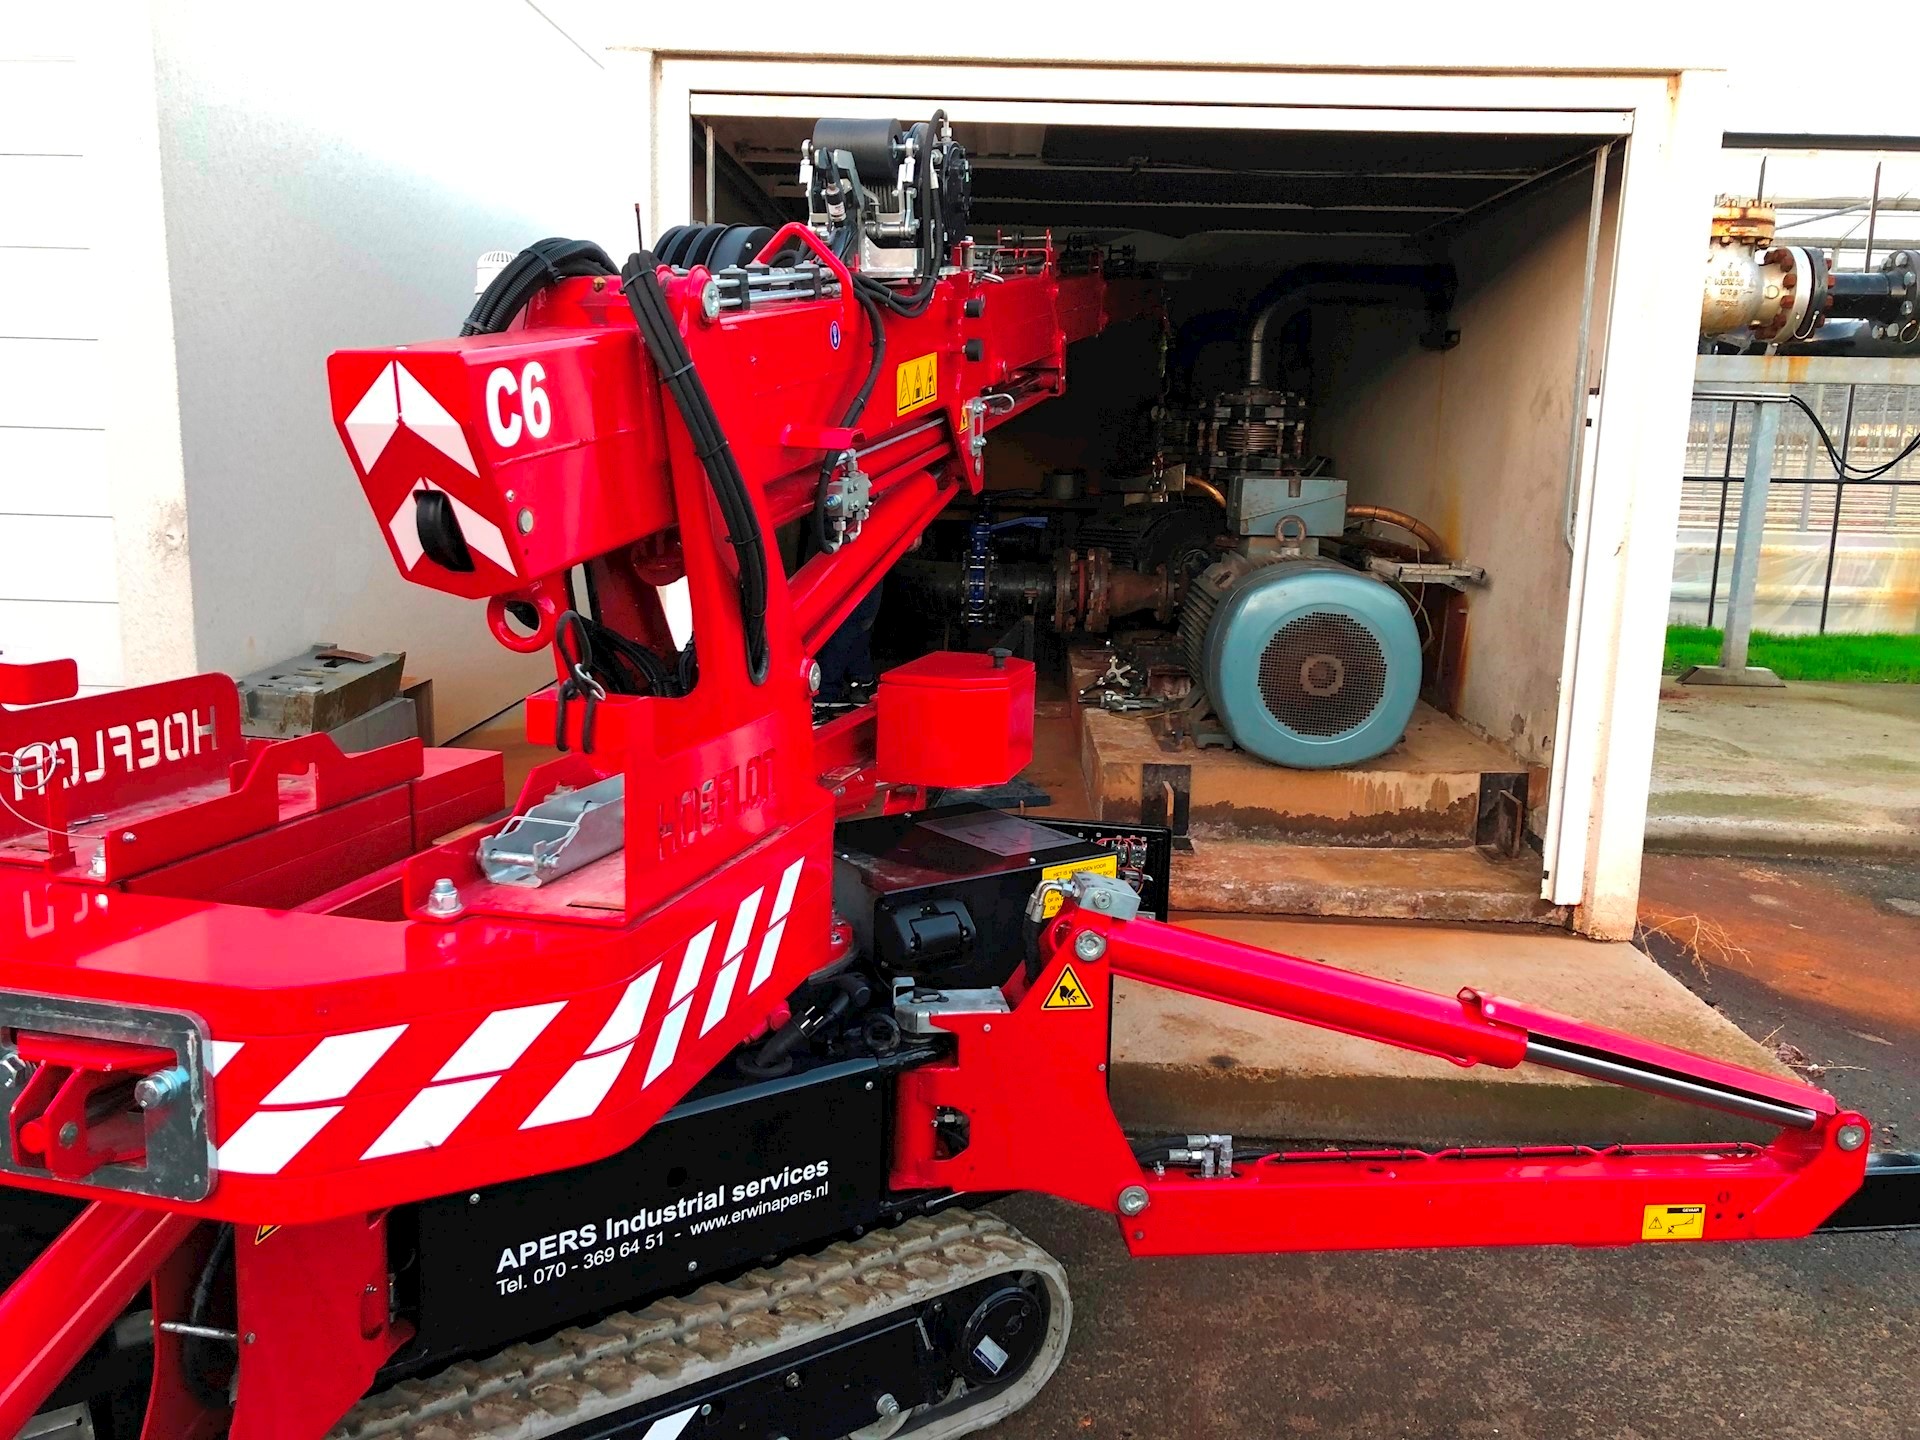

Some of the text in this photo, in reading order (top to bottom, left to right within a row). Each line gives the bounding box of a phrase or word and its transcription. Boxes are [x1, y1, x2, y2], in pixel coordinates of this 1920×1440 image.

[485, 360, 552, 449] C6
[496, 1275, 529, 1296] Tel.
[533, 1262, 567, 1286] 070
[583, 1247, 615, 1270] 369
[620, 1239, 641, 1258] 64
[645, 1231, 664, 1250] 51
[690, 1180, 829, 1236] www.erwinapers.nl
[497, 1160, 829, 1273] APERS Industrial services
